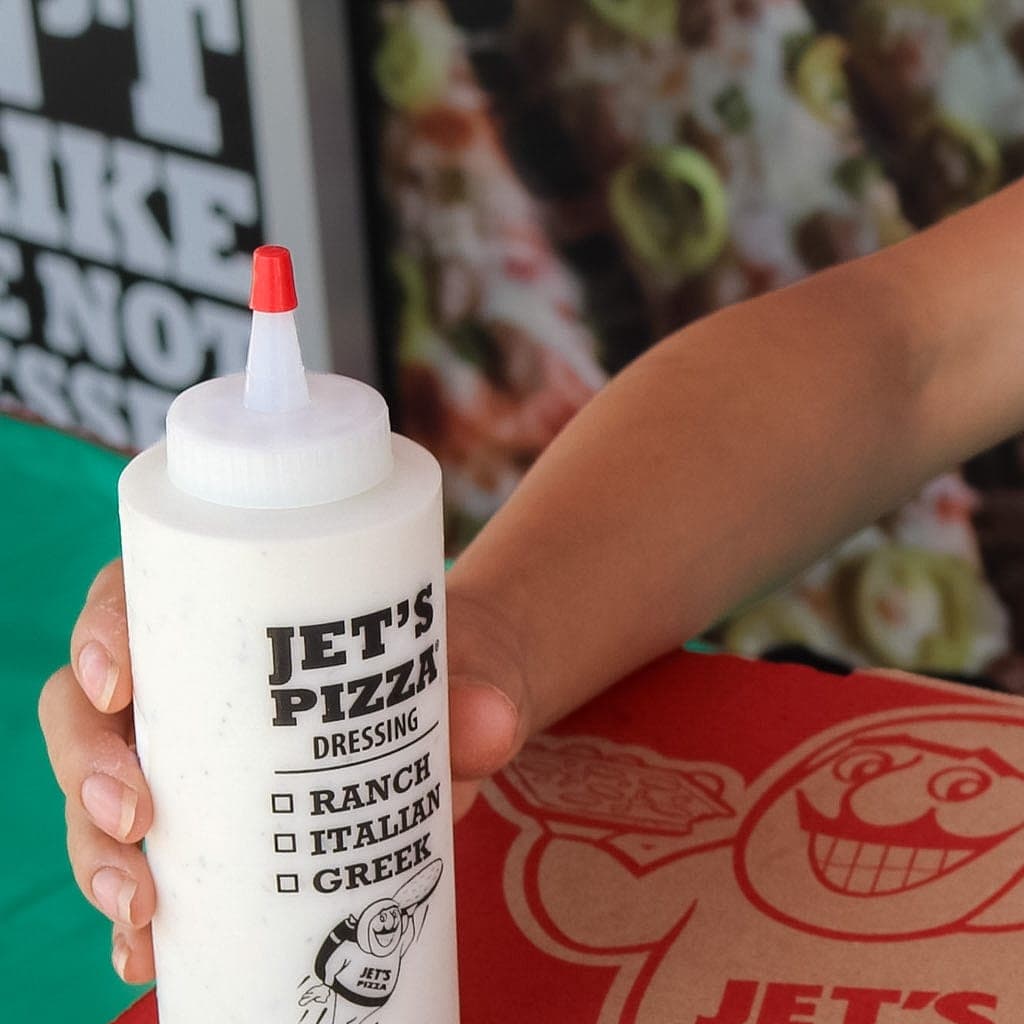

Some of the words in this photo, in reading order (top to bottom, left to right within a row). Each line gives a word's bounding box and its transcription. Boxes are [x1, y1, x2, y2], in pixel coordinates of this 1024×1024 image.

[0, 113, 262, 309] IKE
[266, 582, 434, 686] JET'S
[270, 644, 438, 727] PIZZA
[312, 706, 418, 760] DRESSING
[309, 752, 431, 816] RANCH
[309, 783, 441, 856] ITALIAN
[312, 832, 432, 894] GREEK
[356, 980, 387, 991] PIZZA
[359, 966, 392, 981] JET'S
